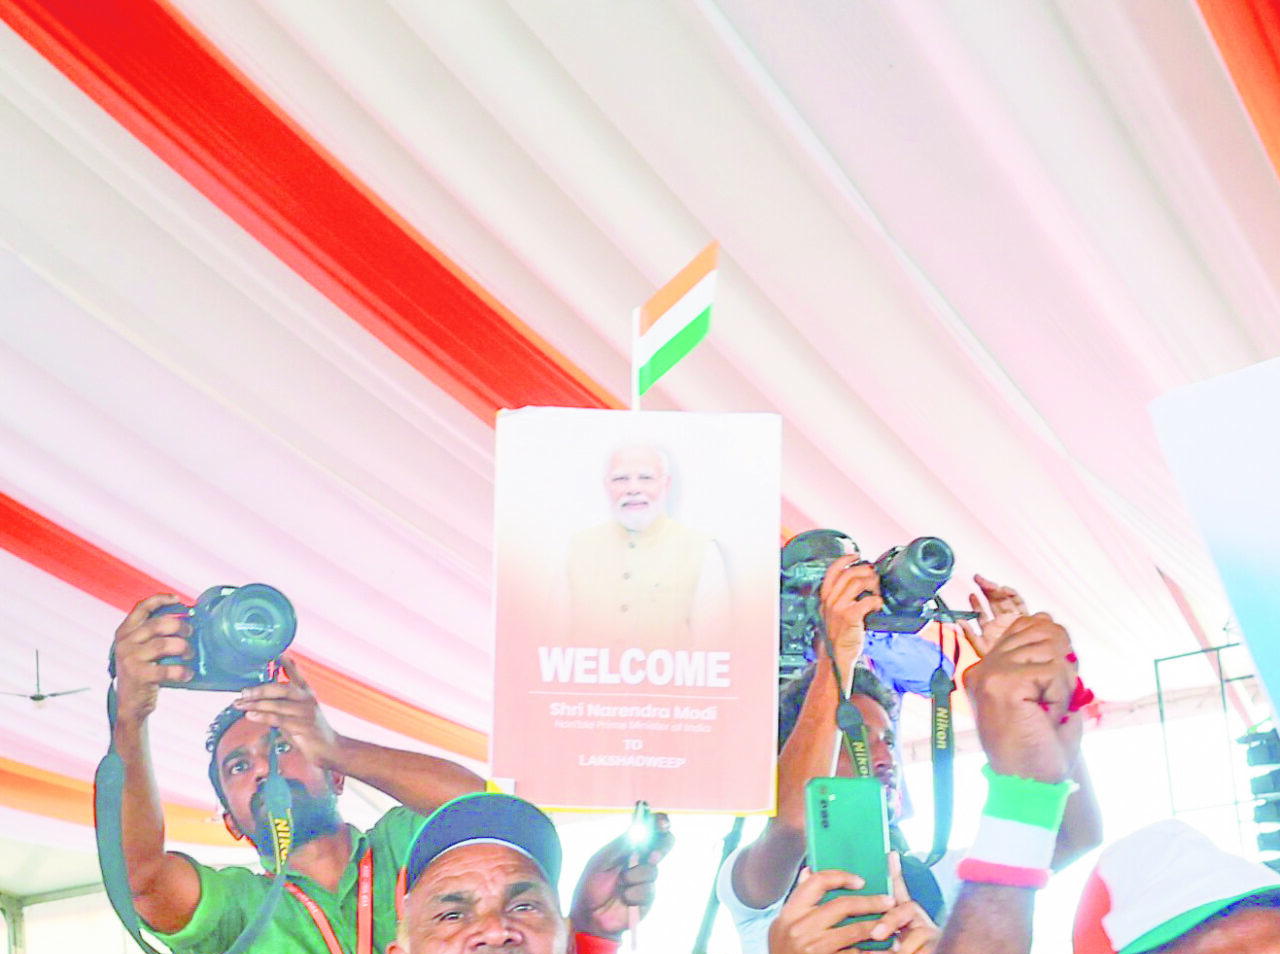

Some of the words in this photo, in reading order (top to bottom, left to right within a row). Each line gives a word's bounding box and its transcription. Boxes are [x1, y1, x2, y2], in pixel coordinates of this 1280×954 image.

[538, 646, 731, 688] WELCOME
[550, 702, 583, 716] Shri
[587, 703, 670, 718] Narendra
[674, 705, 718, 720] Modi
[935, 707, 950, 750] Nikon
[622, 739, 643, 750] TO
[578, 754, 687, 769] LAKSHADWEEP
